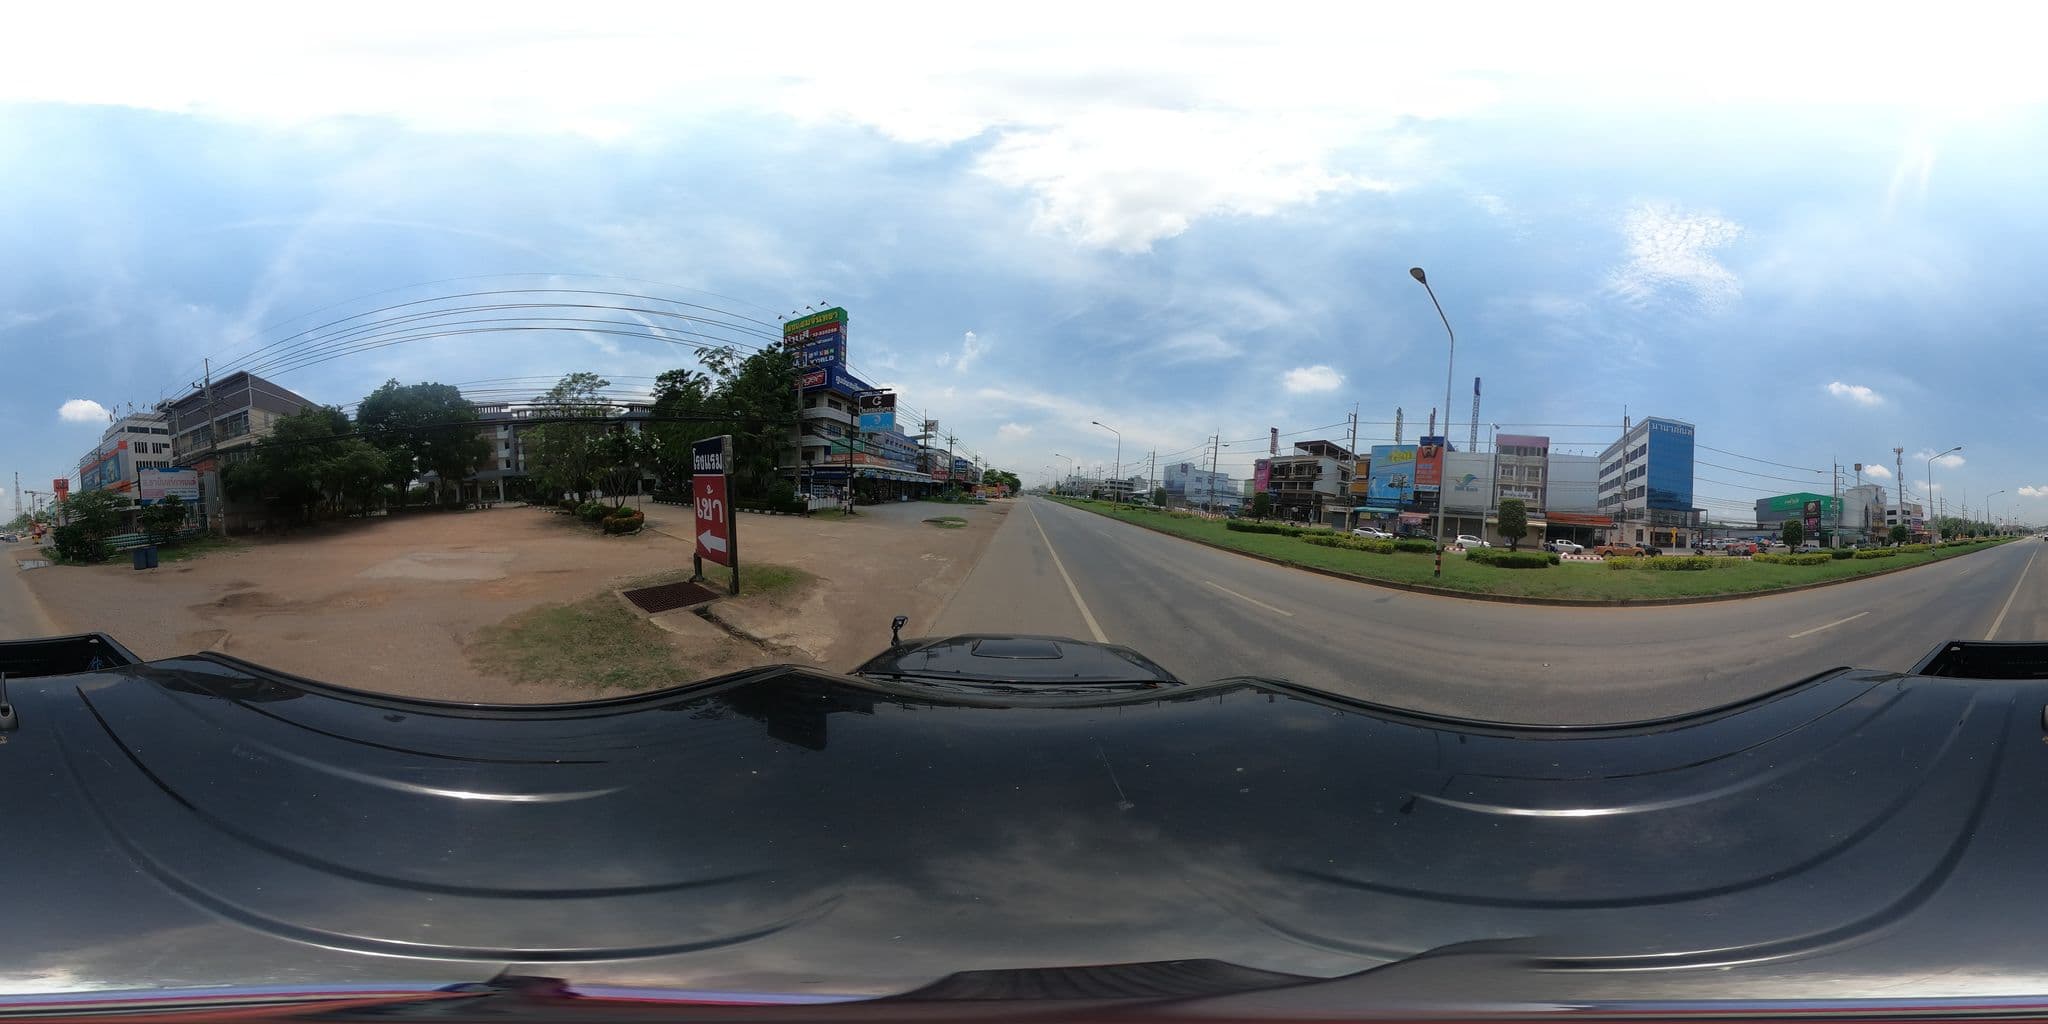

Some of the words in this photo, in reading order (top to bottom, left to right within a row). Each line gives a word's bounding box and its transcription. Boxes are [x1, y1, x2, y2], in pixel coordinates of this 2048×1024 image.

[693, 447, 723, 470] โรงแรม
[697, 485, 724, 523] เข้า
